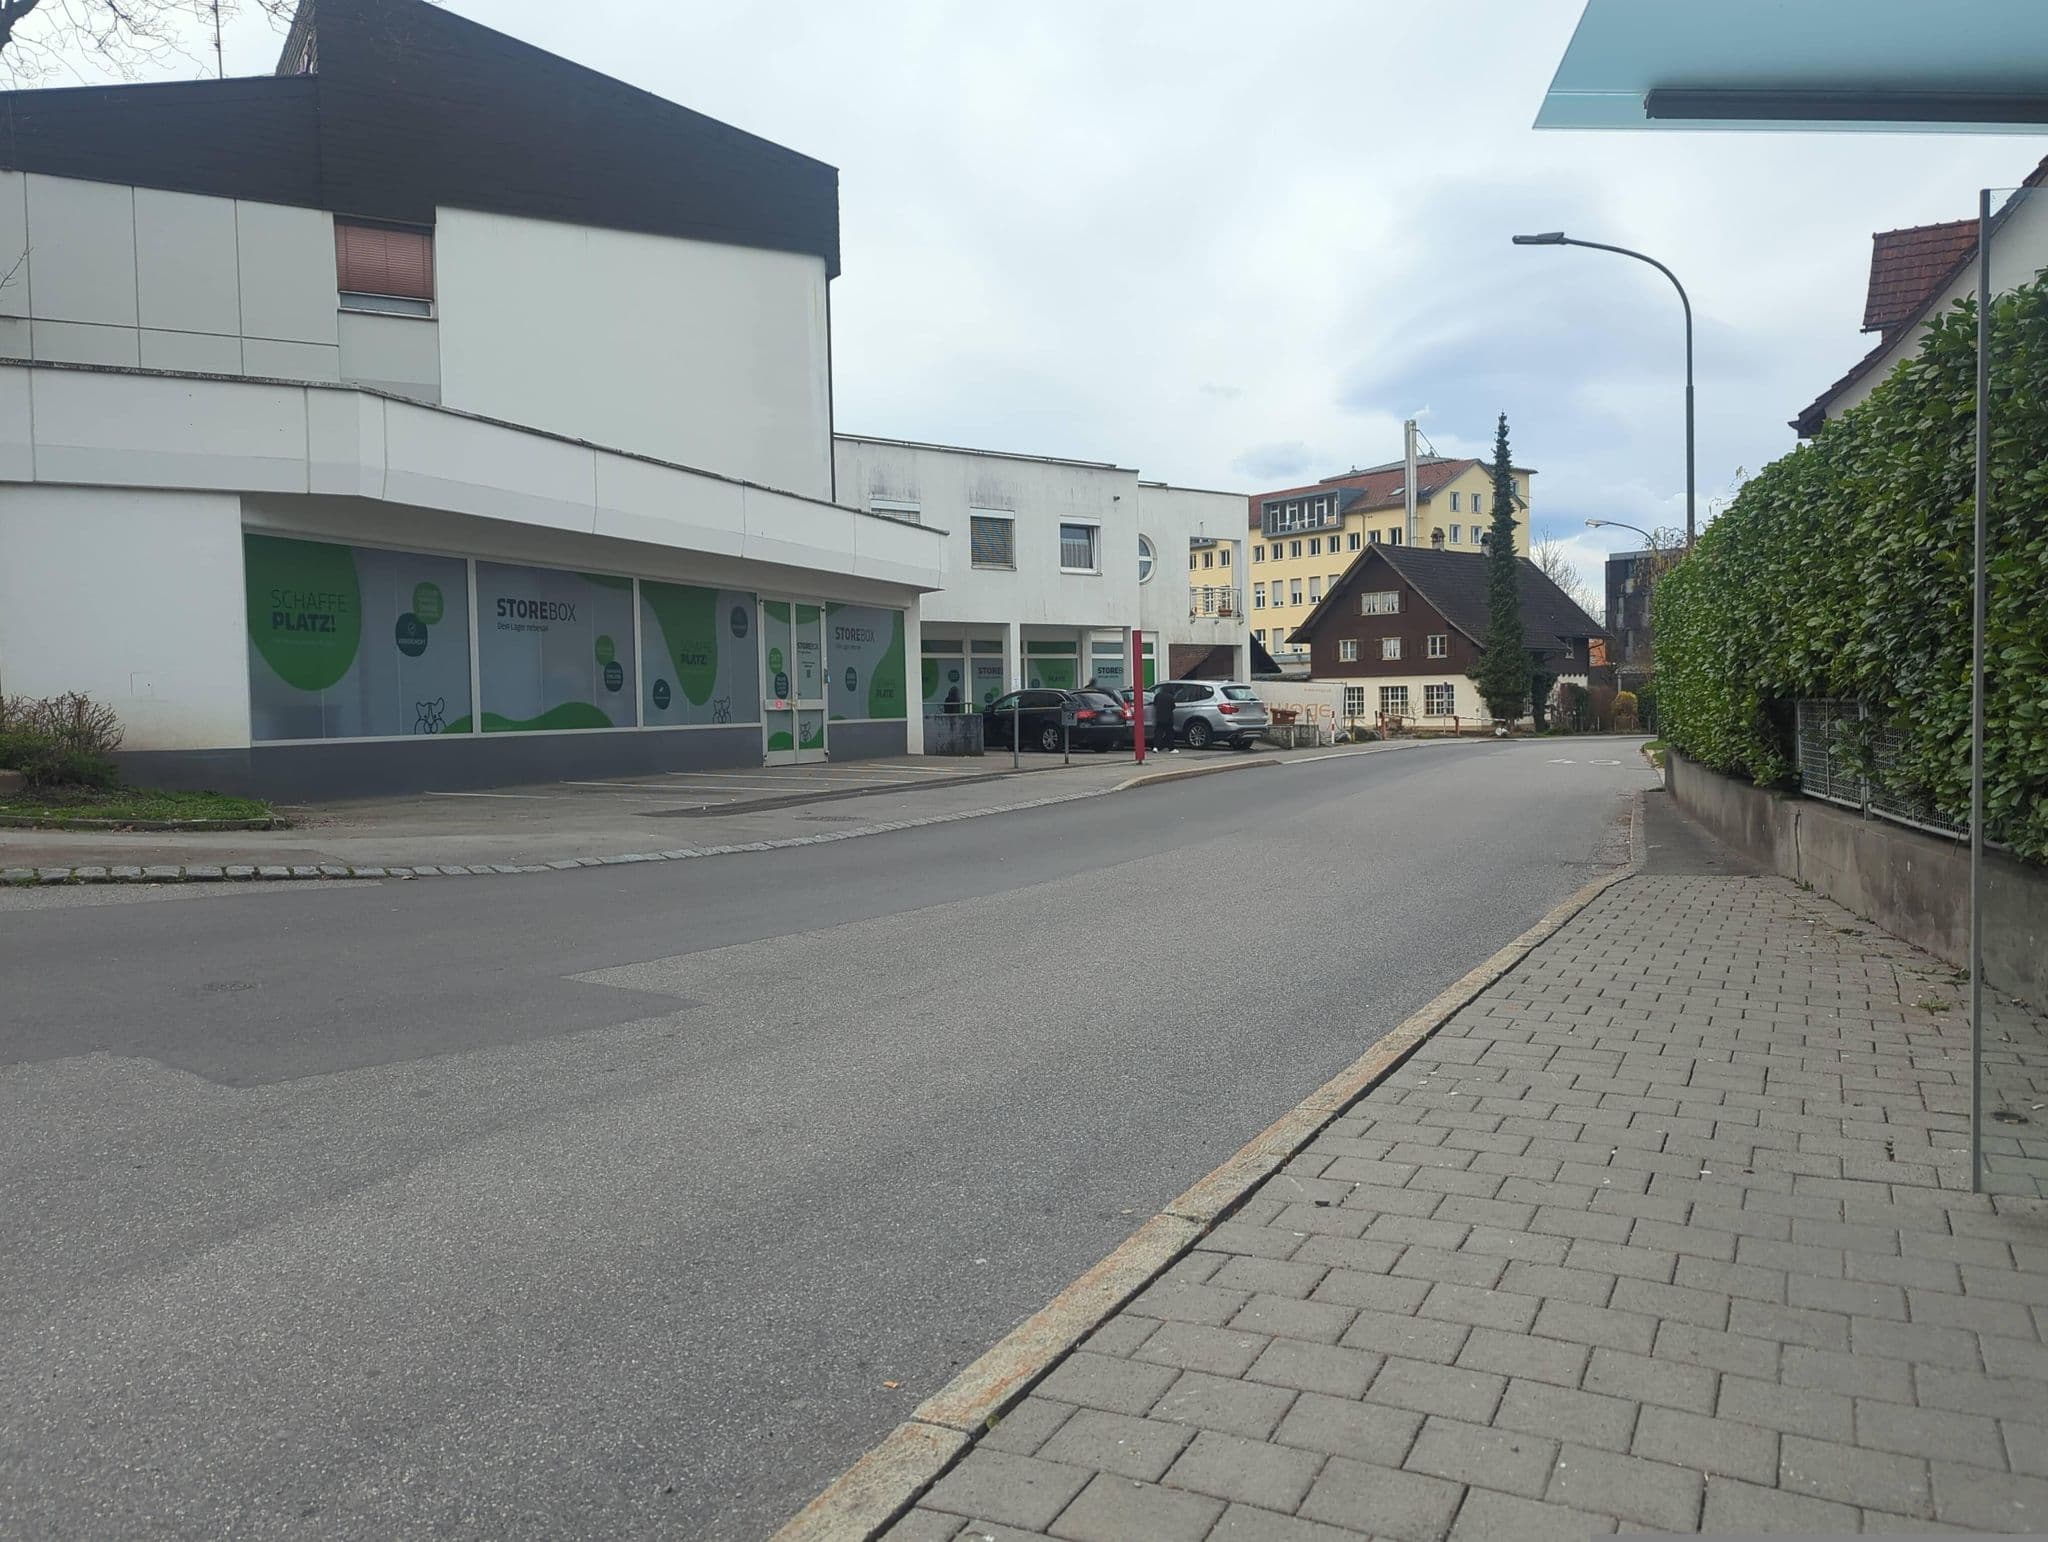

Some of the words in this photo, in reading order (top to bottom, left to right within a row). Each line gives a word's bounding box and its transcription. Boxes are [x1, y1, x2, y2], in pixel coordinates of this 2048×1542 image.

[271, 589, 352, 612] SCHAFFE
[497, 598, 577, 622] STOREBOX
[272, 611, 336, 632] PLATZ!
[835, 627, 876, 643] STOREBOX
